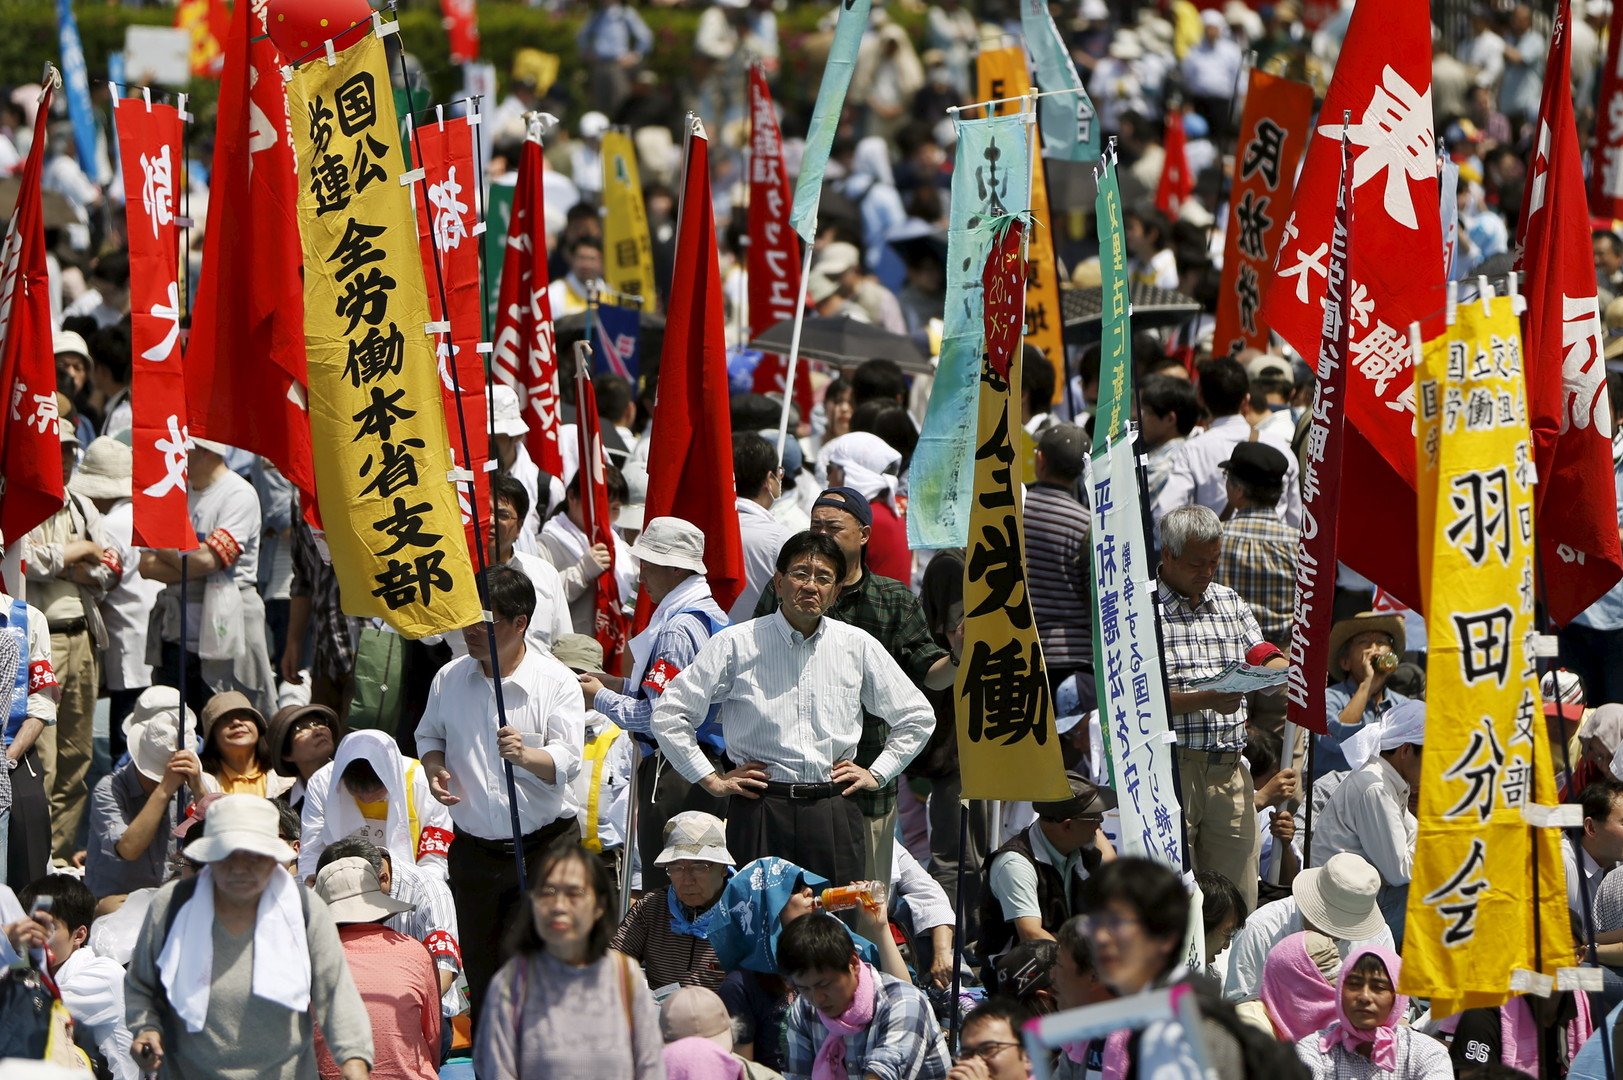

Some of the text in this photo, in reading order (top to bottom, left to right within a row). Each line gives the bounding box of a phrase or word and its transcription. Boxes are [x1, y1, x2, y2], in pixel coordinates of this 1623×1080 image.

[307, 96, 352, 218] 労連
[333, 70, 390, 196] 国公
[326, 218, 455, 611] 全労働本省支部
[1424, 467, 1514, 946] 羽田分会
[1465, 1040, 1491, 1063] 96
